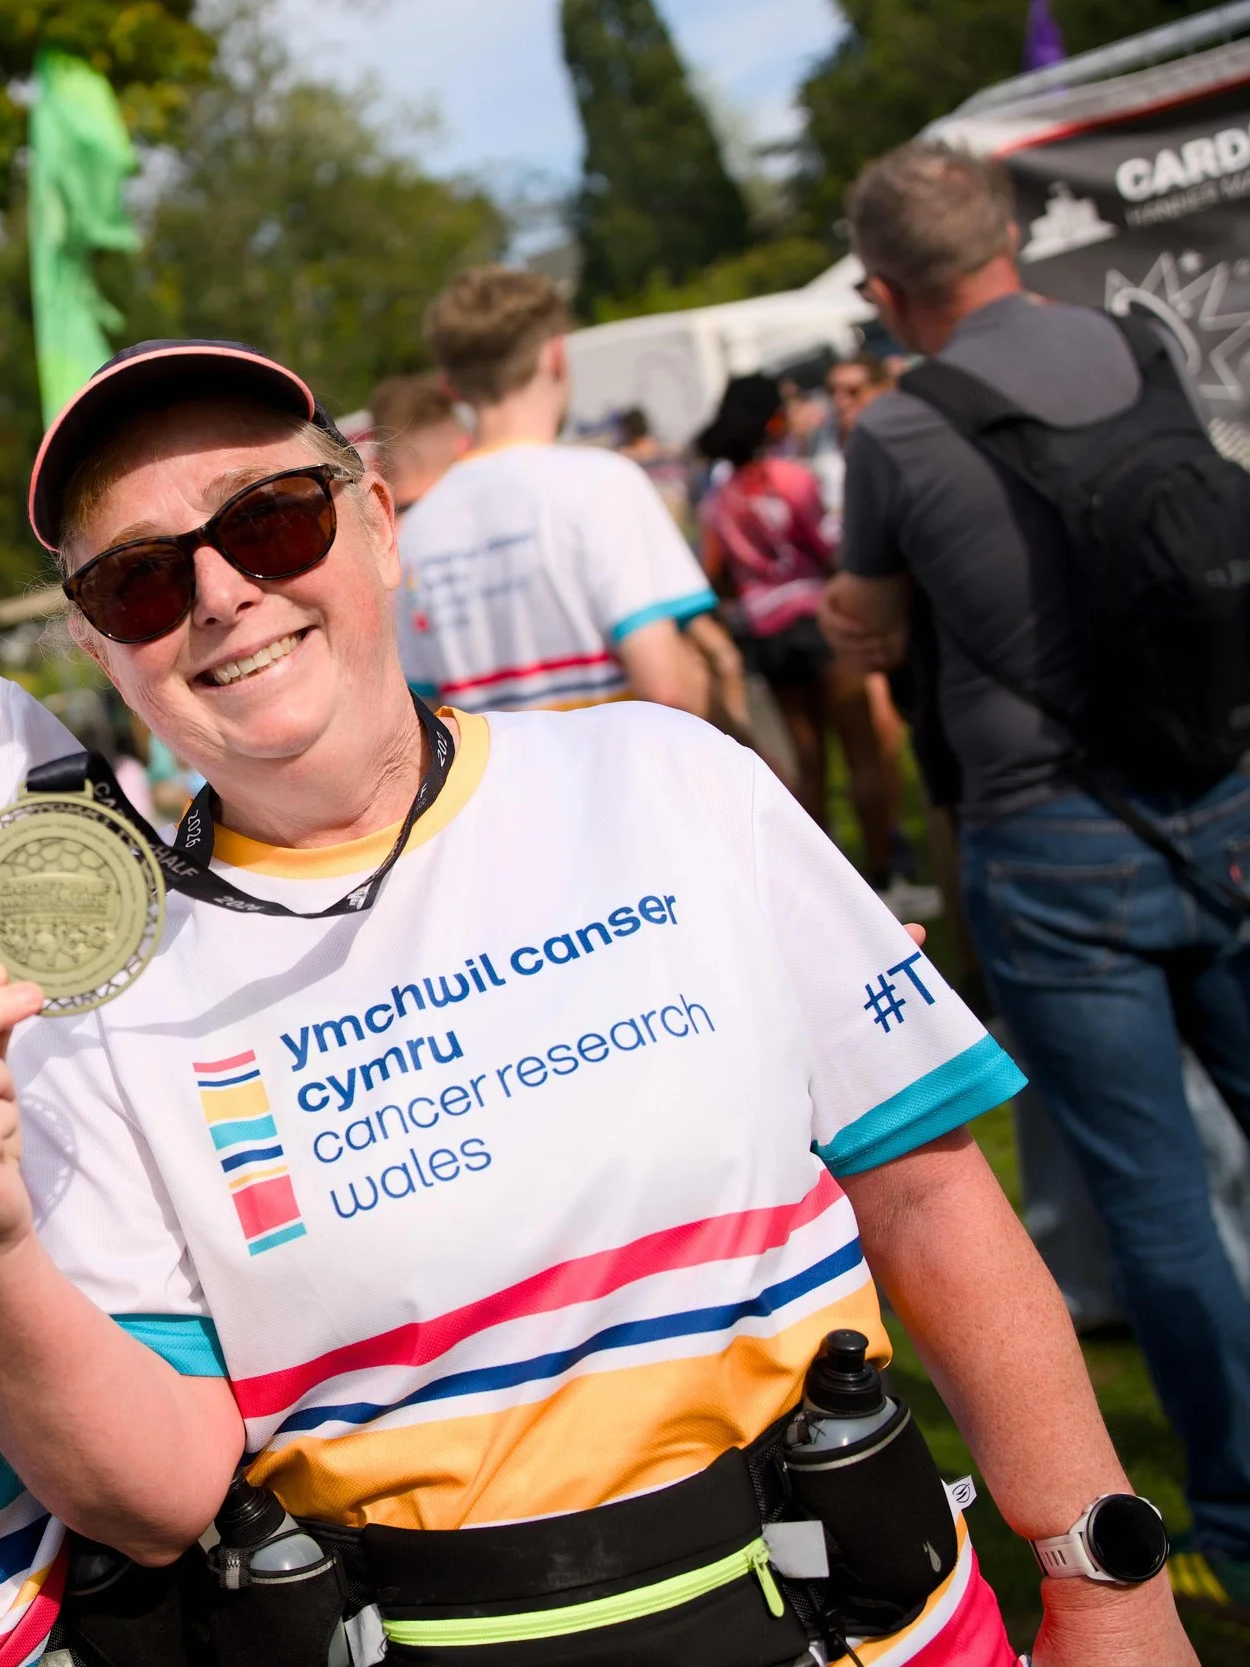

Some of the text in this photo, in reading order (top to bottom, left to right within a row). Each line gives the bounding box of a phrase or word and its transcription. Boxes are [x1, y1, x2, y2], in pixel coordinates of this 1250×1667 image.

[1116, 125, 1250, 202] CARD
[185, 809, 201, 848] 2026
[280, 894, 678, 1072] ymchwil canser
[296, 1030, 464, 1113] cymru
[313, 993, 716, 1164] cancer research
[329, 1137, 492, 1220] wales
